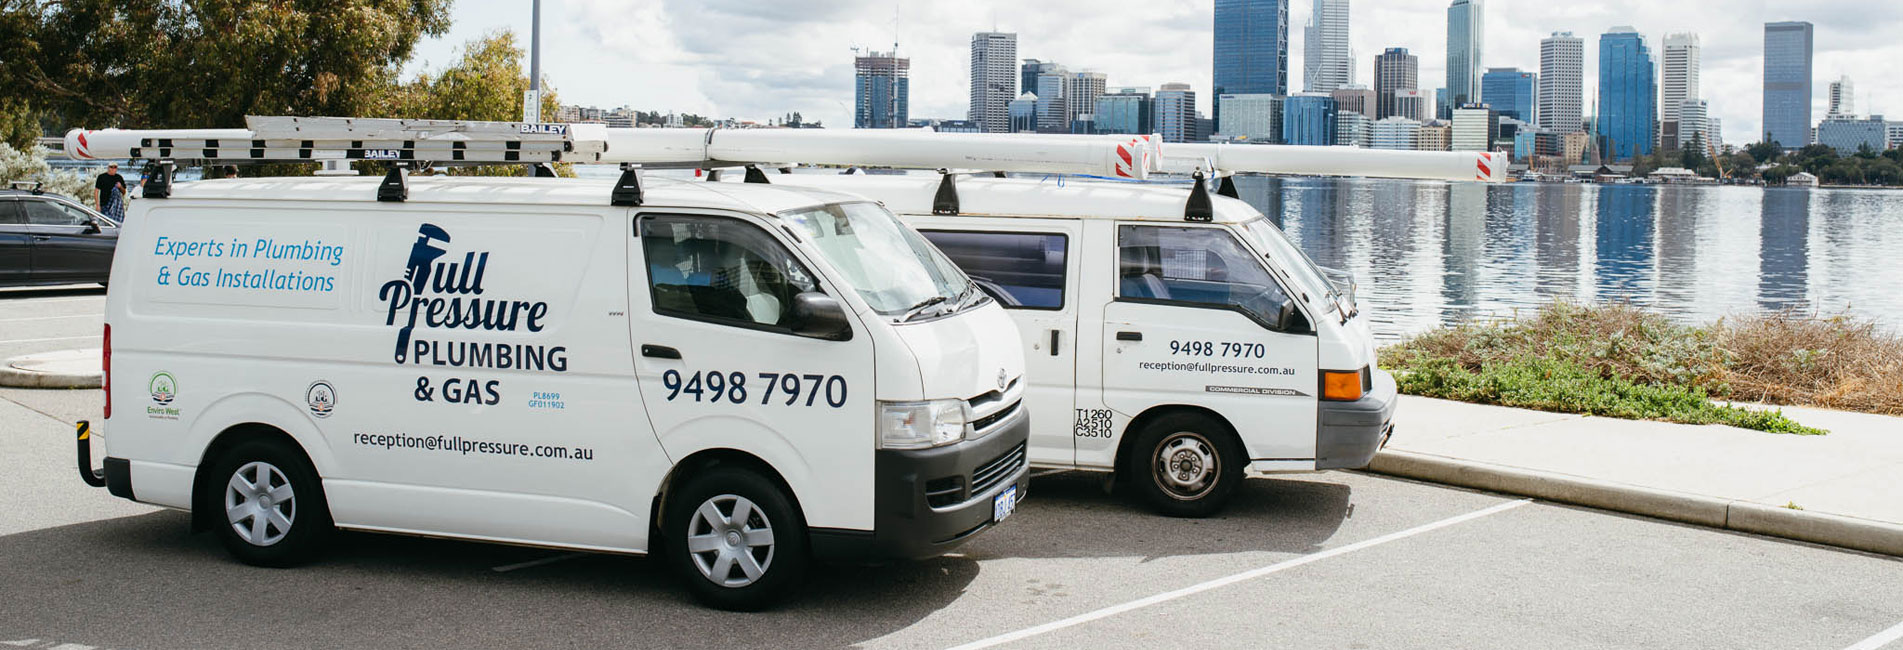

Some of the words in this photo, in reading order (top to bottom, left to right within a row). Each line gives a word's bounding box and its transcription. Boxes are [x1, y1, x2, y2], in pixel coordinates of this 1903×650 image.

[521, 125, 566, 134] BAILEY
[364, 149, 400, 158] BAILEY
[155, 236, 224, 259] Experts
[230, 239, 247, 258] in
[253, 239, 343, 266] Plumbing
[157, 266, 171, 286] &
[177, 267, 210, 287] Gas
[216, 268, 335, 292] Installations
[379, 279, 548, 333] Pressure
[414, 339, 568, 372] PLUMBING
[1170, 340, 1213, 357] 9498
[1221, 342, 1266, 359] 7970
[1139, 360, 1296, 376] reception@fullpressure.com.au
[414, 376, 434, 402] &
[442, 378, 500, 406] GAS
[533, 391, 560, 400] PL8699
[663, 369, 748, 405] 9498
[758, 373, 848, 409] 7970
[1209, 386, 1260, 394] COMMERCIAL
[1261, 388, 1296, 396] DIVISION
[147, 406, 164, 414] Enviro
[165, 407, 180, 415] West
[1075, 408, 1113, 420] T1260
[1075, 418, 1113, 430] A2510
[1075, 427, 1113, 439] C3510
[353, 431, 594, 461] reception@fullpressure.com.au
